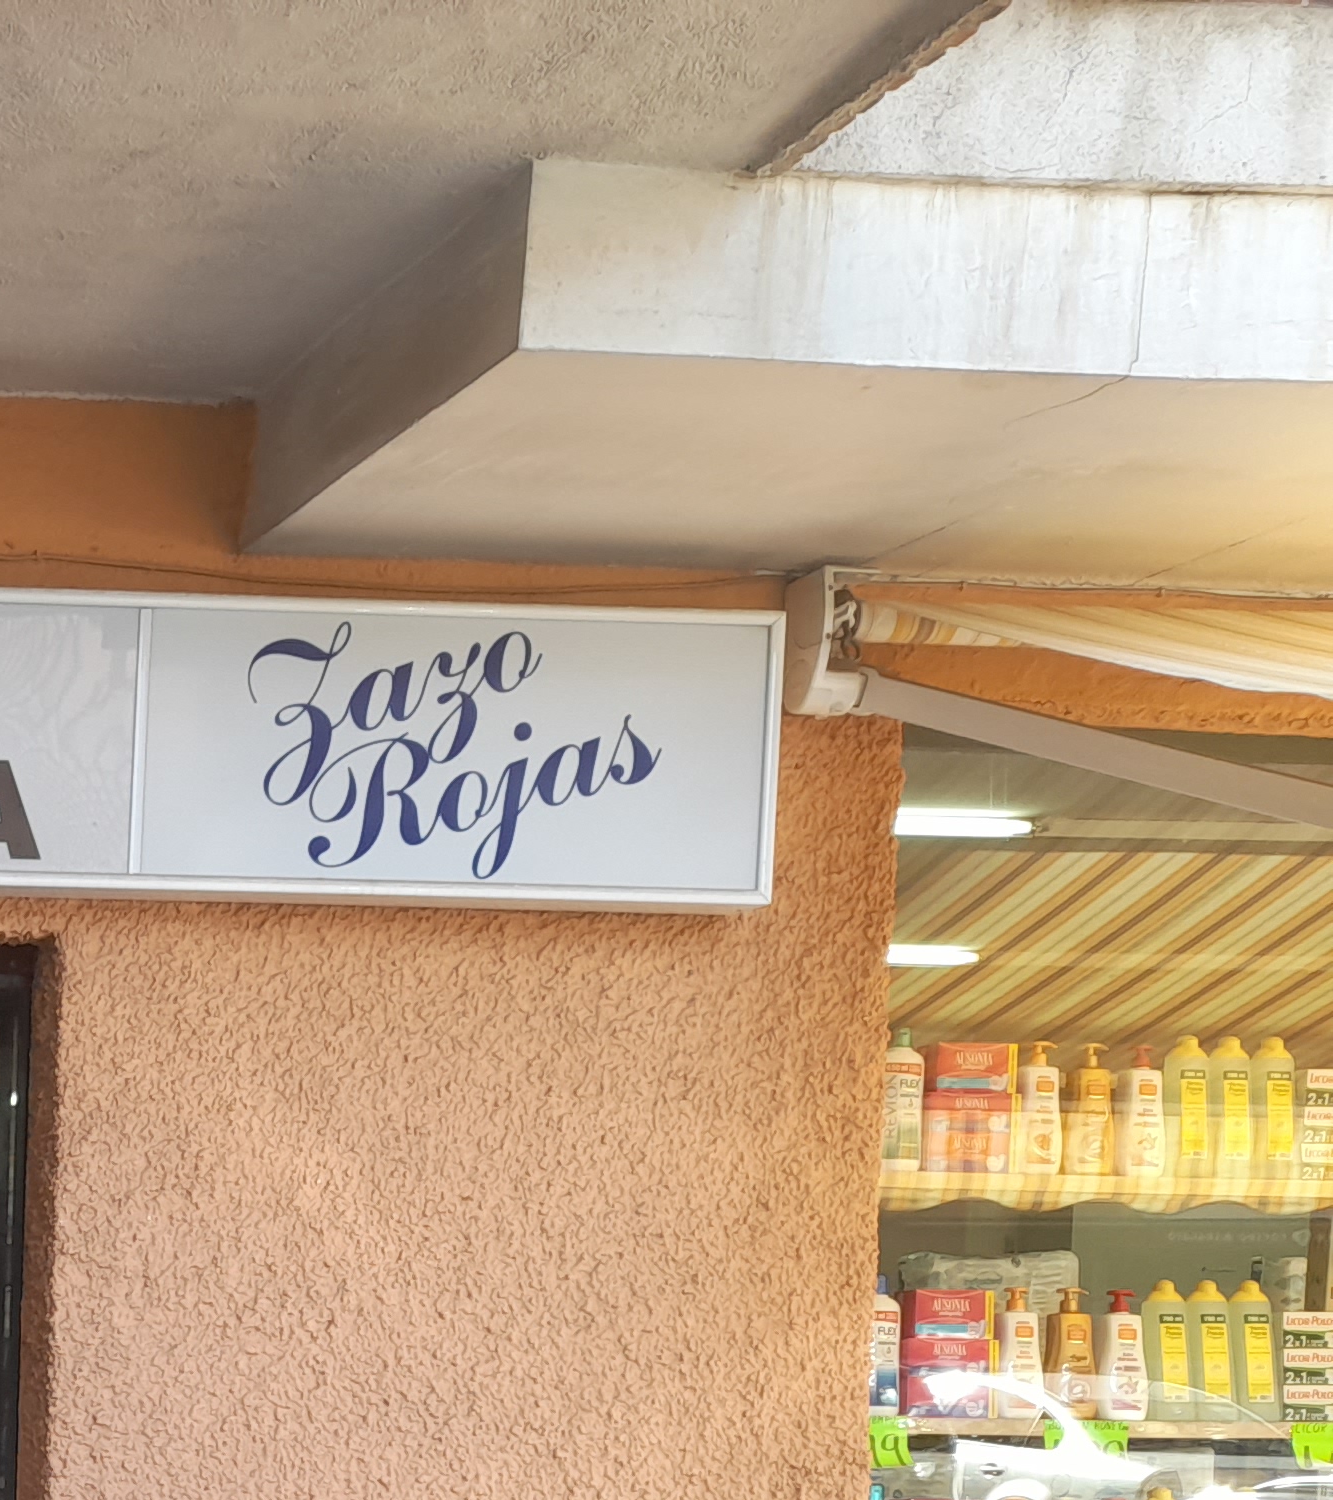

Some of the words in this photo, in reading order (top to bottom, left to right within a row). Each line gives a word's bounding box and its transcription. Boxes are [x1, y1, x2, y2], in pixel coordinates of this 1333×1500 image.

[247, 621, 543, 806] Zazo
[307, 713, 662, 879] Rojas
[956, 1051, 993, 1066] AUSONIA
[899, 1078, 922, 1089] FLEX
[954, 1097, 989, 1109] AUSONIA
[1307, 1093, 1329, 1106] 2x1
[1303, 1130, 1327, 1142] 2x1
[952, 1135, 988, 1150] AUSONIA
[933, 1298, 971, 1312] AUSONIA
[877, 1326, 897, 1336] FLEX
[1285, 1335, 1307, 1347] 2x1
[932, 1344, 967, 1355] AUSONIA
[1285, 1372, 1307, 1384] 2x1
[1285, 1408, 1307, 1421] 2x1
